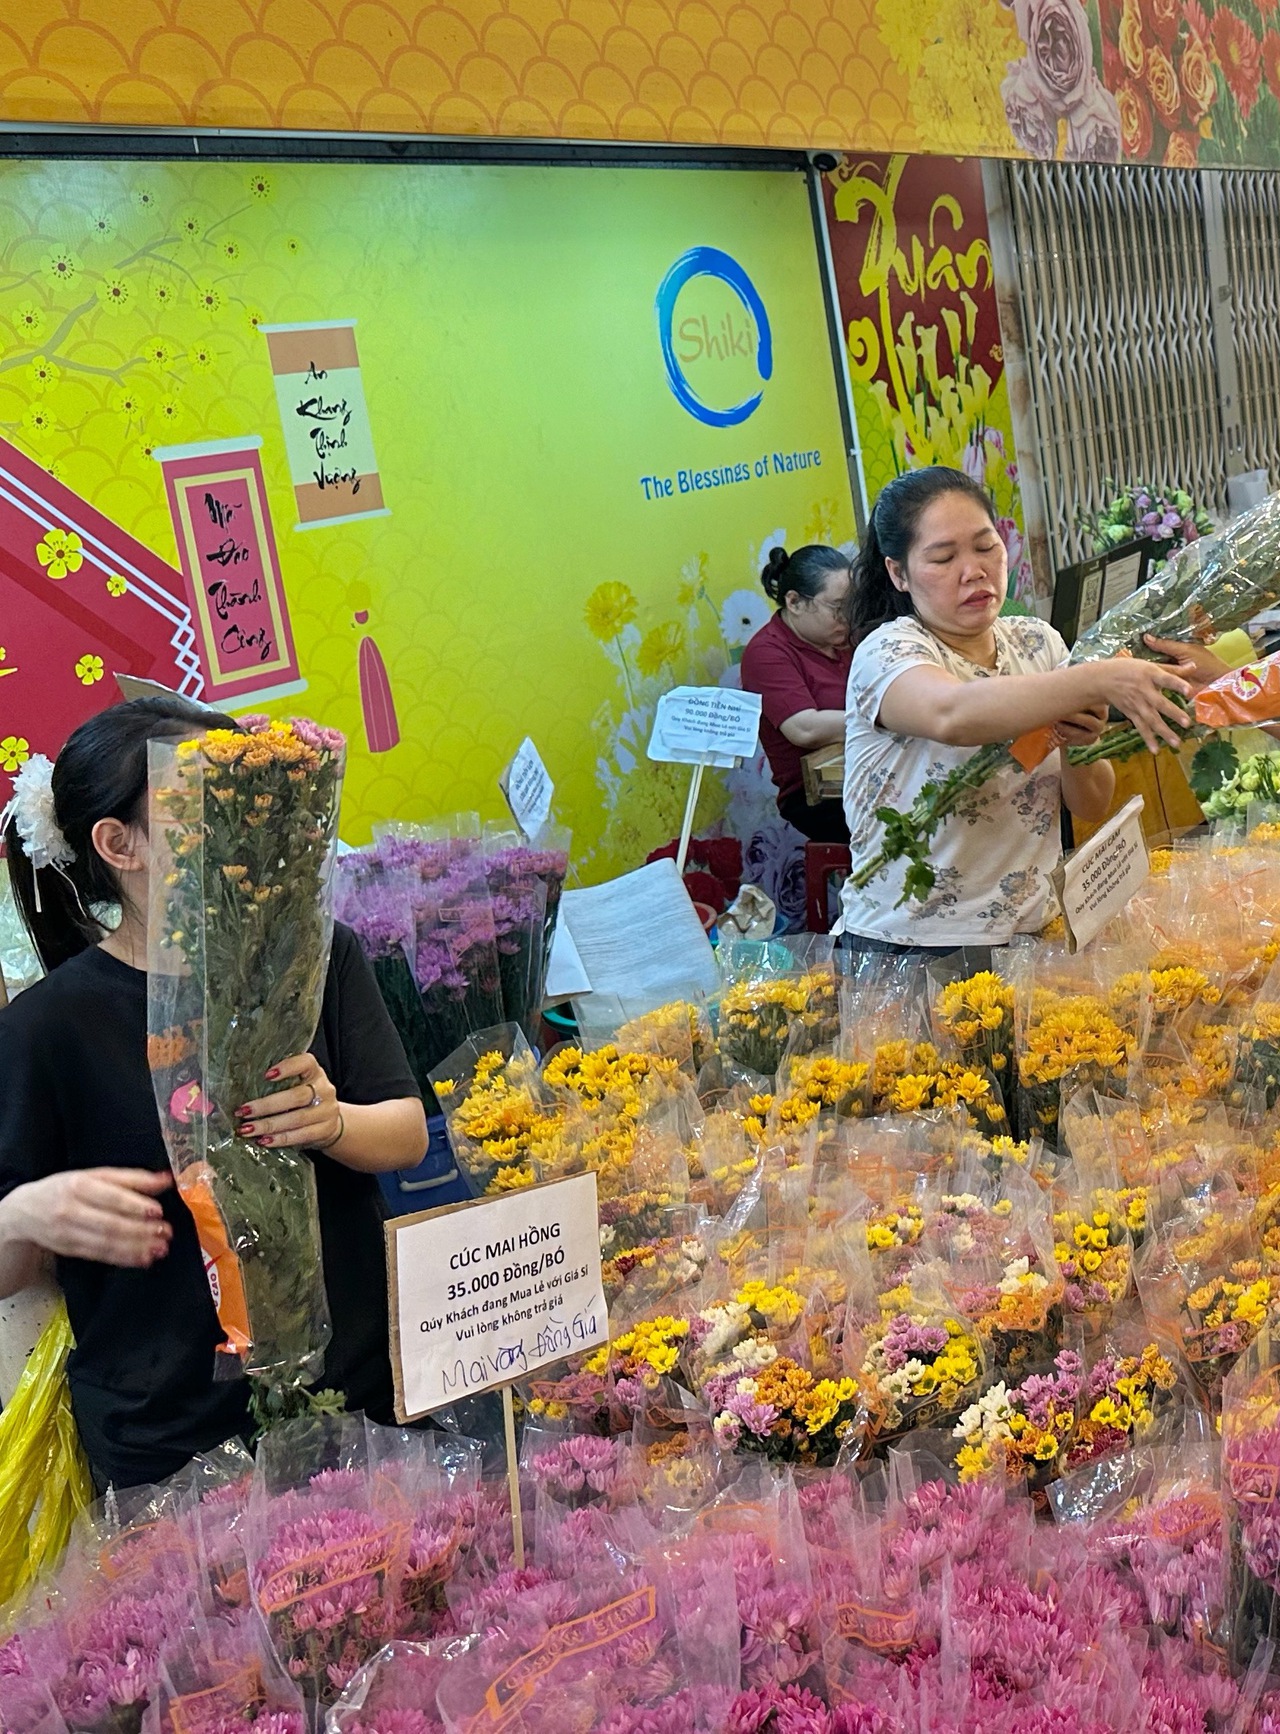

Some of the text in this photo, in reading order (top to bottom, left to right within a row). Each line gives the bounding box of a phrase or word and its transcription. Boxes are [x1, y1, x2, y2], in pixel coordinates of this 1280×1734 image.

[678, 312, 754, 363] Shiki
[304, 361, 328, 385] An
[296, 396, 352, 426] Khang
[640, 449, 822, 501] The Blessings of Nature
[1082, 867, 1102, 892] 35.000
[449, 1222, 561, 1271] CÚC MAI HỒNG
[446, 1303, 479, 1326] Khách
[482, 1294, 508, 1314] đang
[509, 1287, 532, 1303] Mua
[534, 1279, 545, 1295] Lẻ
[546, 1275, 563, 1290] với
[564, 1268, 579, 1284] Giá
[447, 1245, 565, 1301] 35.000 Đồng/BÓ
[455, 1295, 564, 1342] Vui lòng không trả giá
[442, 1356, 489, 1394] Mai
